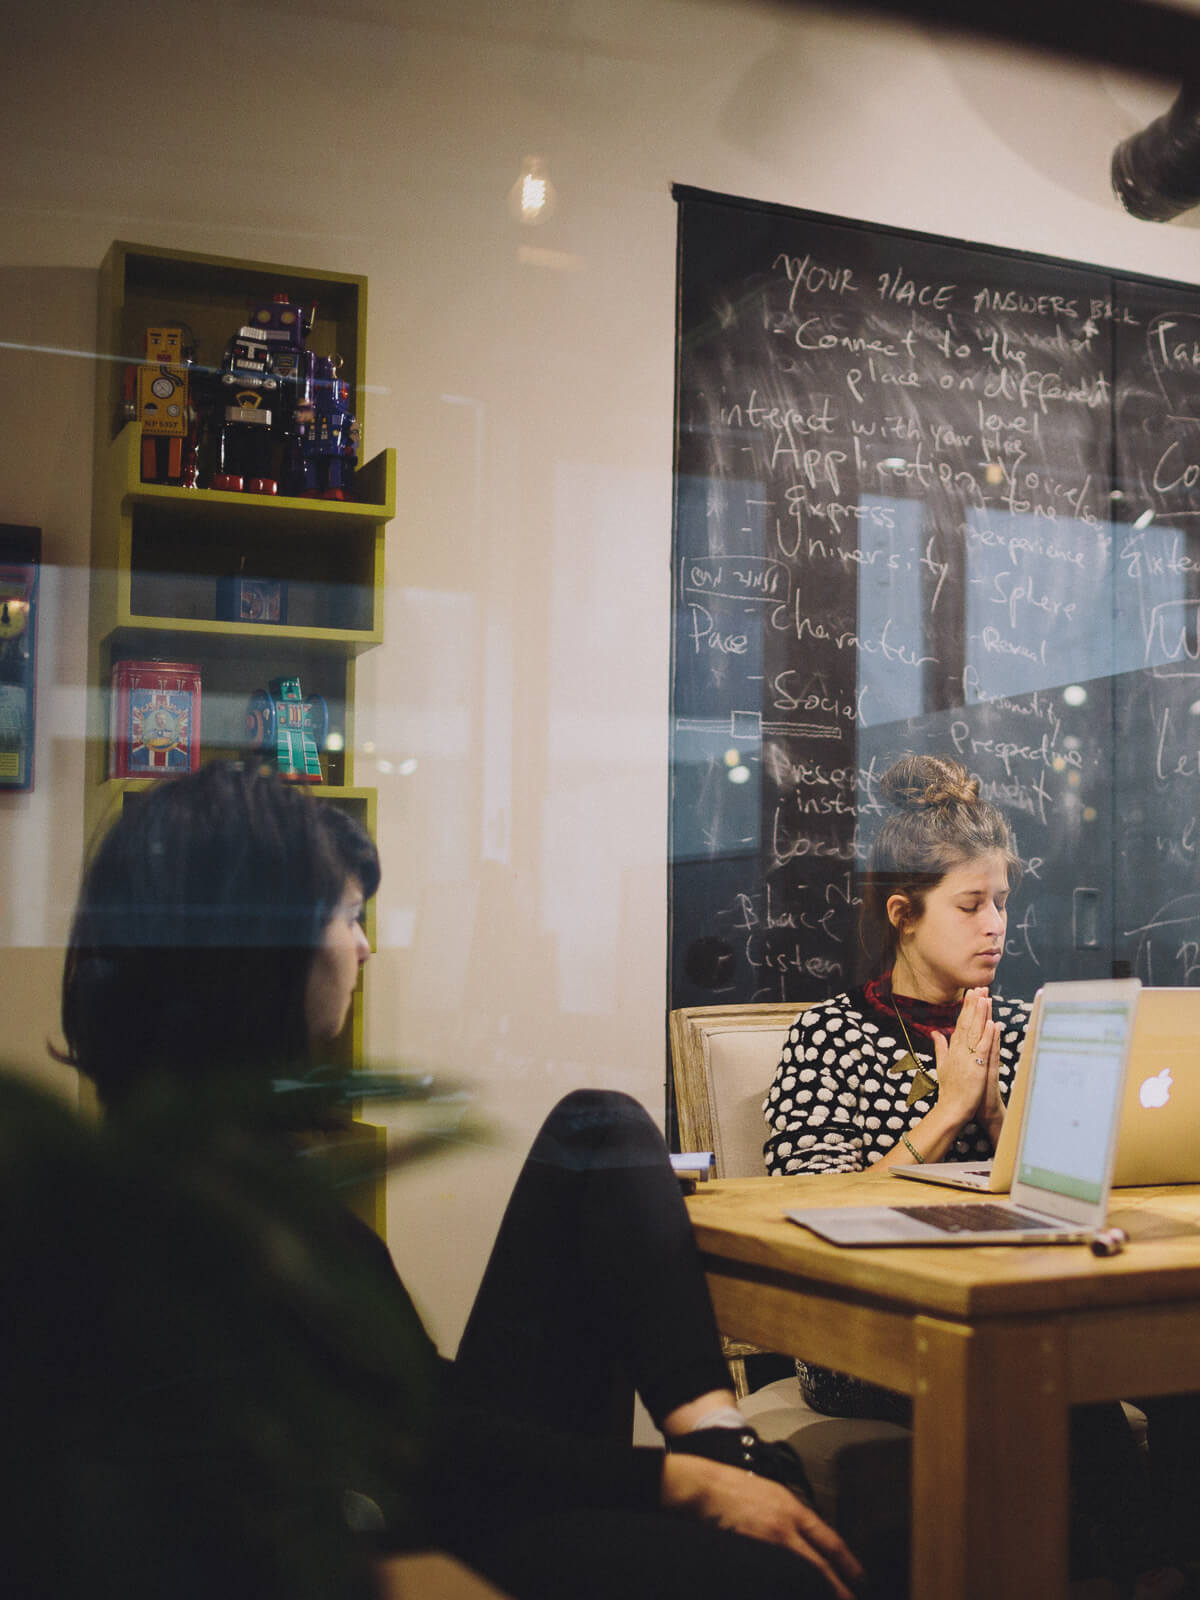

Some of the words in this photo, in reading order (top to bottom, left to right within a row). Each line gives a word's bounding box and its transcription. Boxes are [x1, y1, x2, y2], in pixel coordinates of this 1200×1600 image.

[795, 317, 917, 359] Connect
[938, 329, 972, 359] to
[983, 331, 1027, 369] the
[847, 358, 921, 403] place
[941, 371, 975, 392] on
[773, 669, 869, 727] Social
[746, 933, 844, 978] Listen
